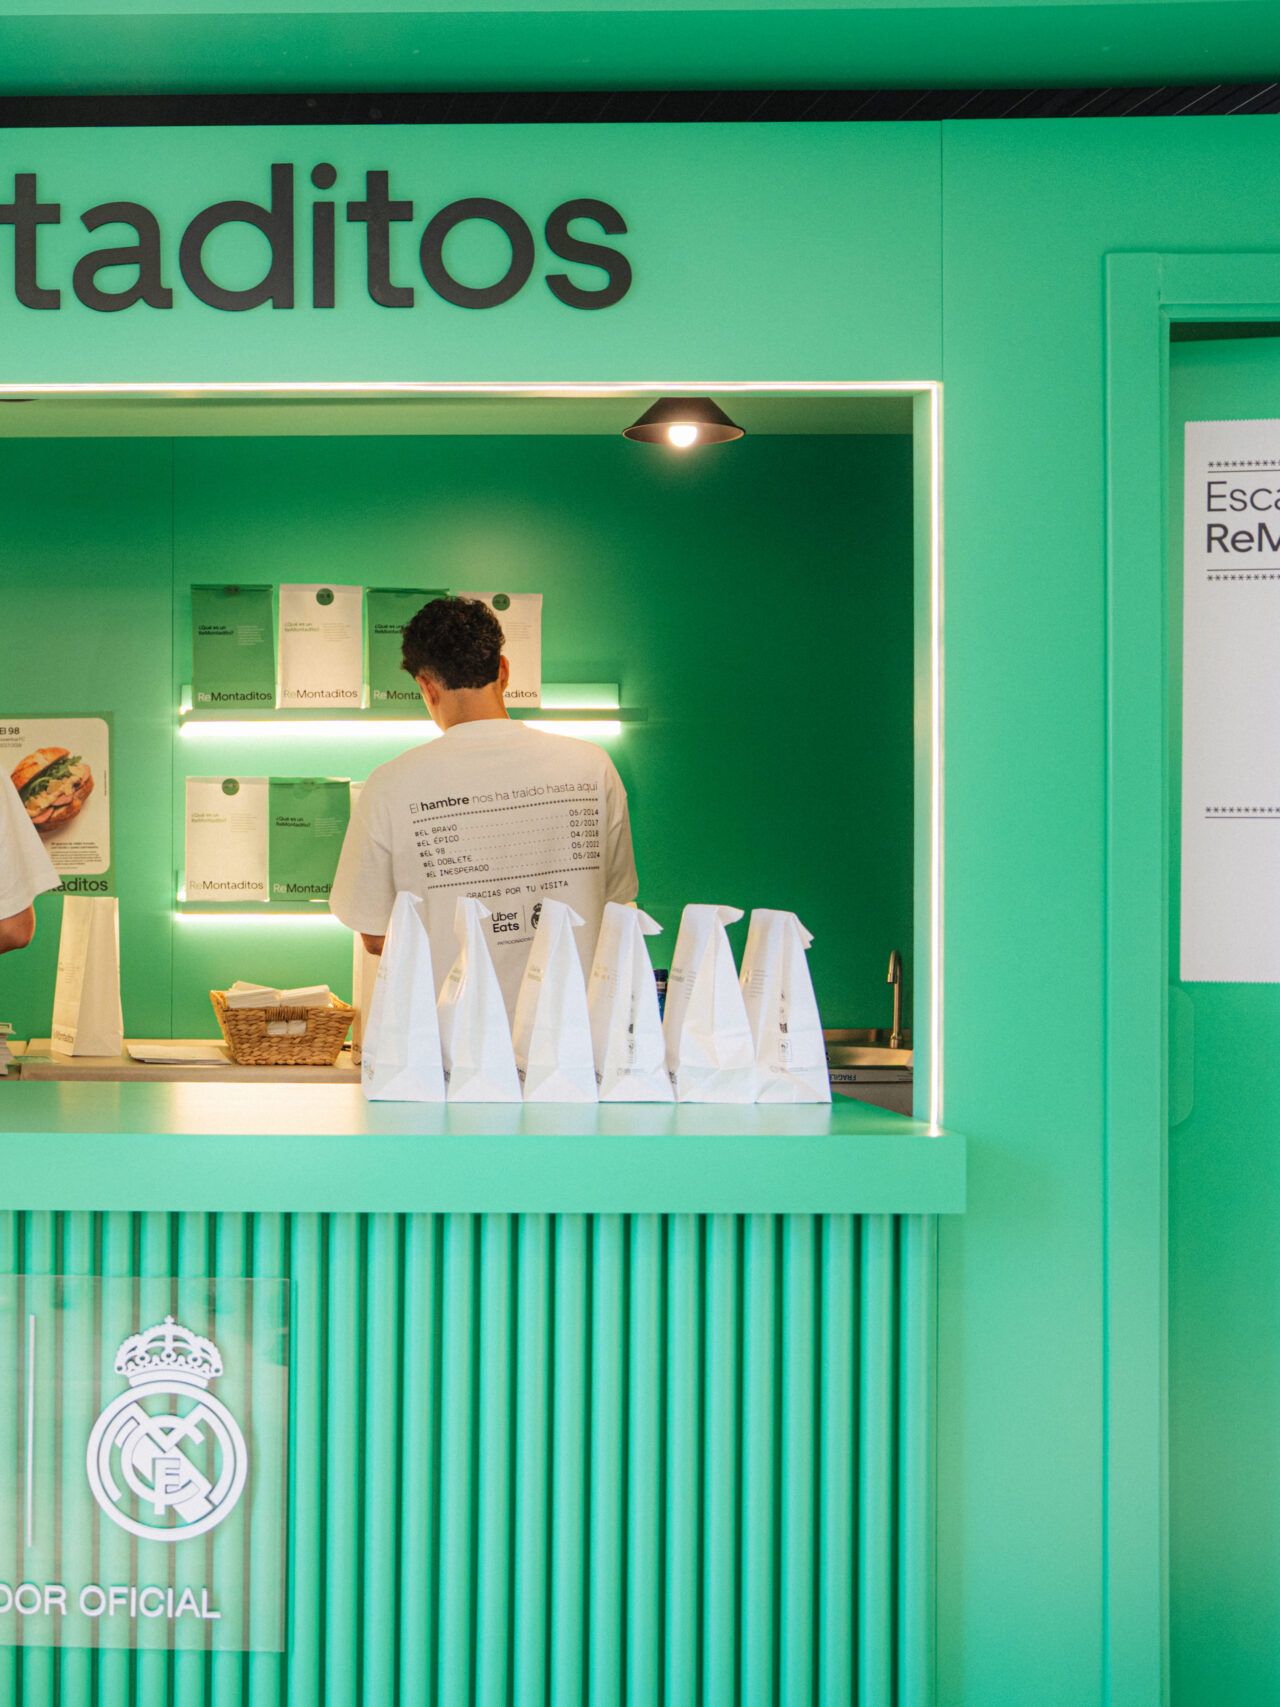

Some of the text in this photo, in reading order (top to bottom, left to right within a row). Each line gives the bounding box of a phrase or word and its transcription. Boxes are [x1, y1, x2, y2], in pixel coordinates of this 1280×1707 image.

[198, 692, 272, 702] ReMontaditos
[284, 689, 358, 699] ReMontaditos
[8, 727, 20, 735] 98
[409, 803, 419, 814] El
[420, 796, 470, 811] hambre
[472, 794, 493, 803] nos
[495, 792, 510, 801] ha
[512, 786, 544, 799] traído
[546, 784, 575, 793] hasta
[432, 824, 458, 834] BRAVO
[438, 855, 473, 866] DOBLETE
[440, 864, 489, 876] INESPERADO
[190, 880, 264, 890] ReMontaditos
[540, 881, 568, 890] VISITA
[491, 912, 517, 922] Uber
[493, 923, 519, 933] Eats
[80, 1585, 221, 1619] OFICIAL
